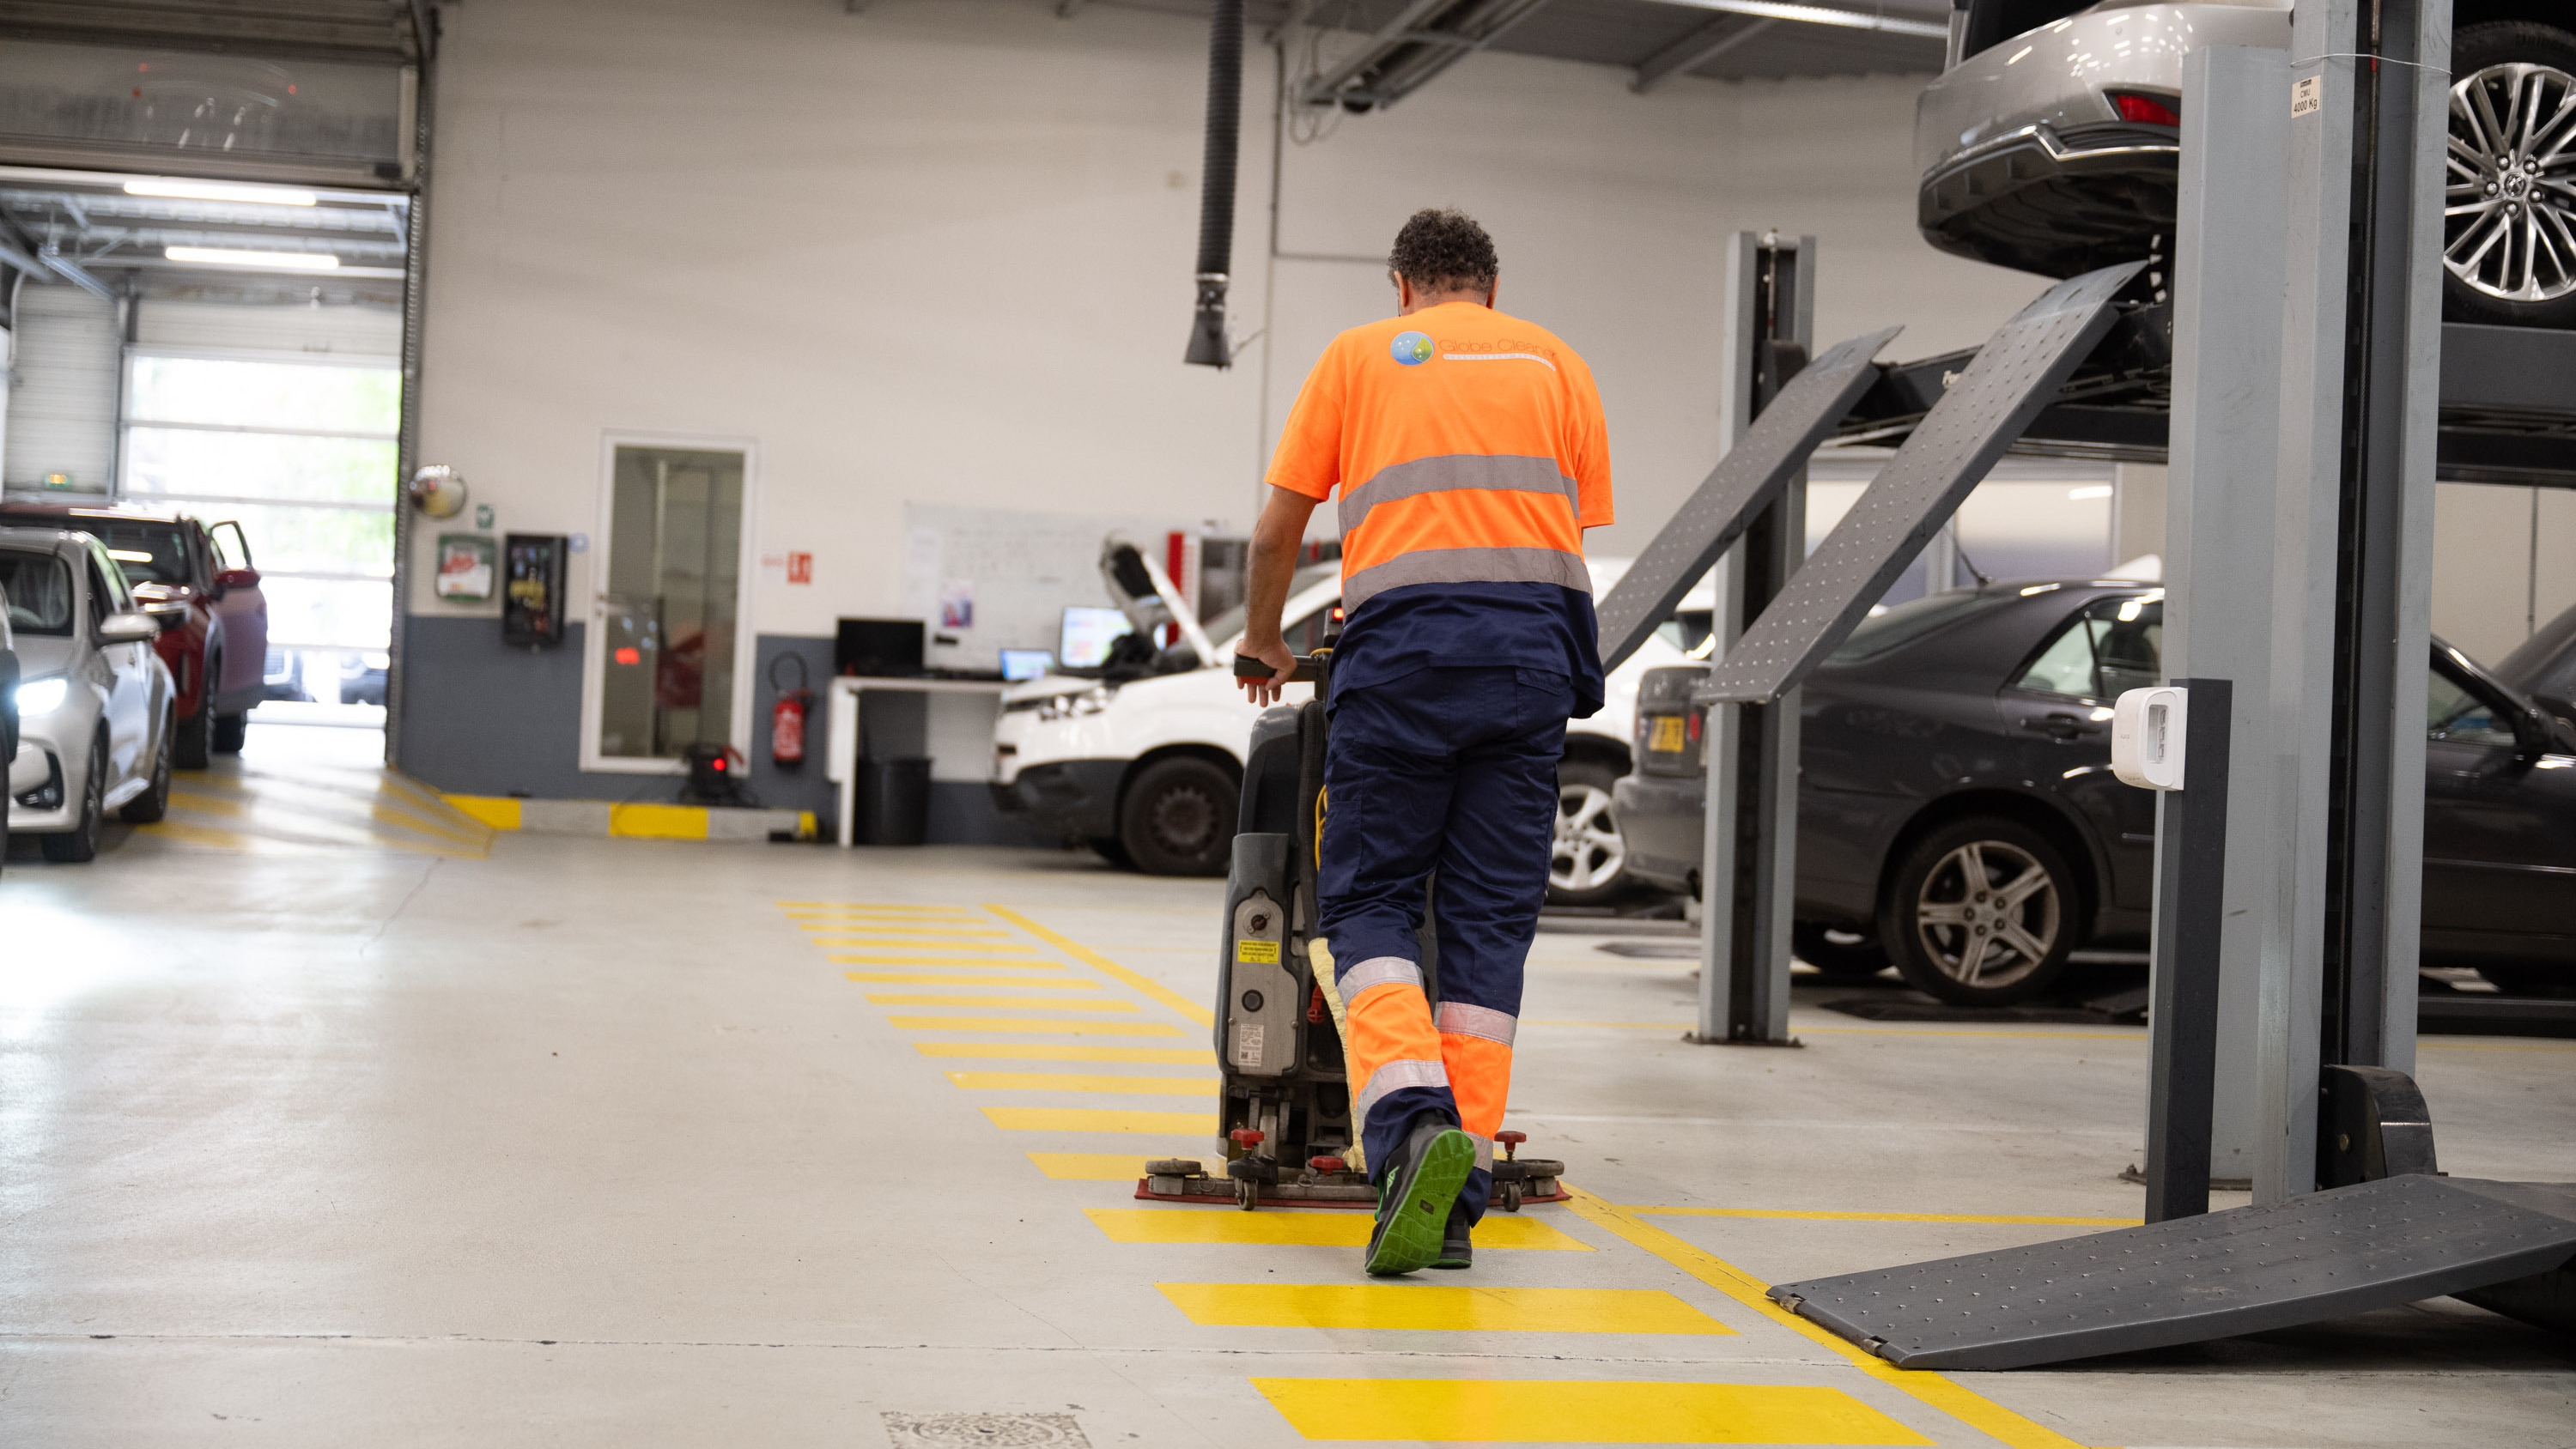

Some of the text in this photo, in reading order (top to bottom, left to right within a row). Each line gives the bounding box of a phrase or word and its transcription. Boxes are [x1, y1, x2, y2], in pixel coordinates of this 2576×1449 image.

[2300, 88, 2311, 98] CMU
[2294, 98, 2318, 112] 4000 Kg
[1438, 339, 1492, 353] Globe
